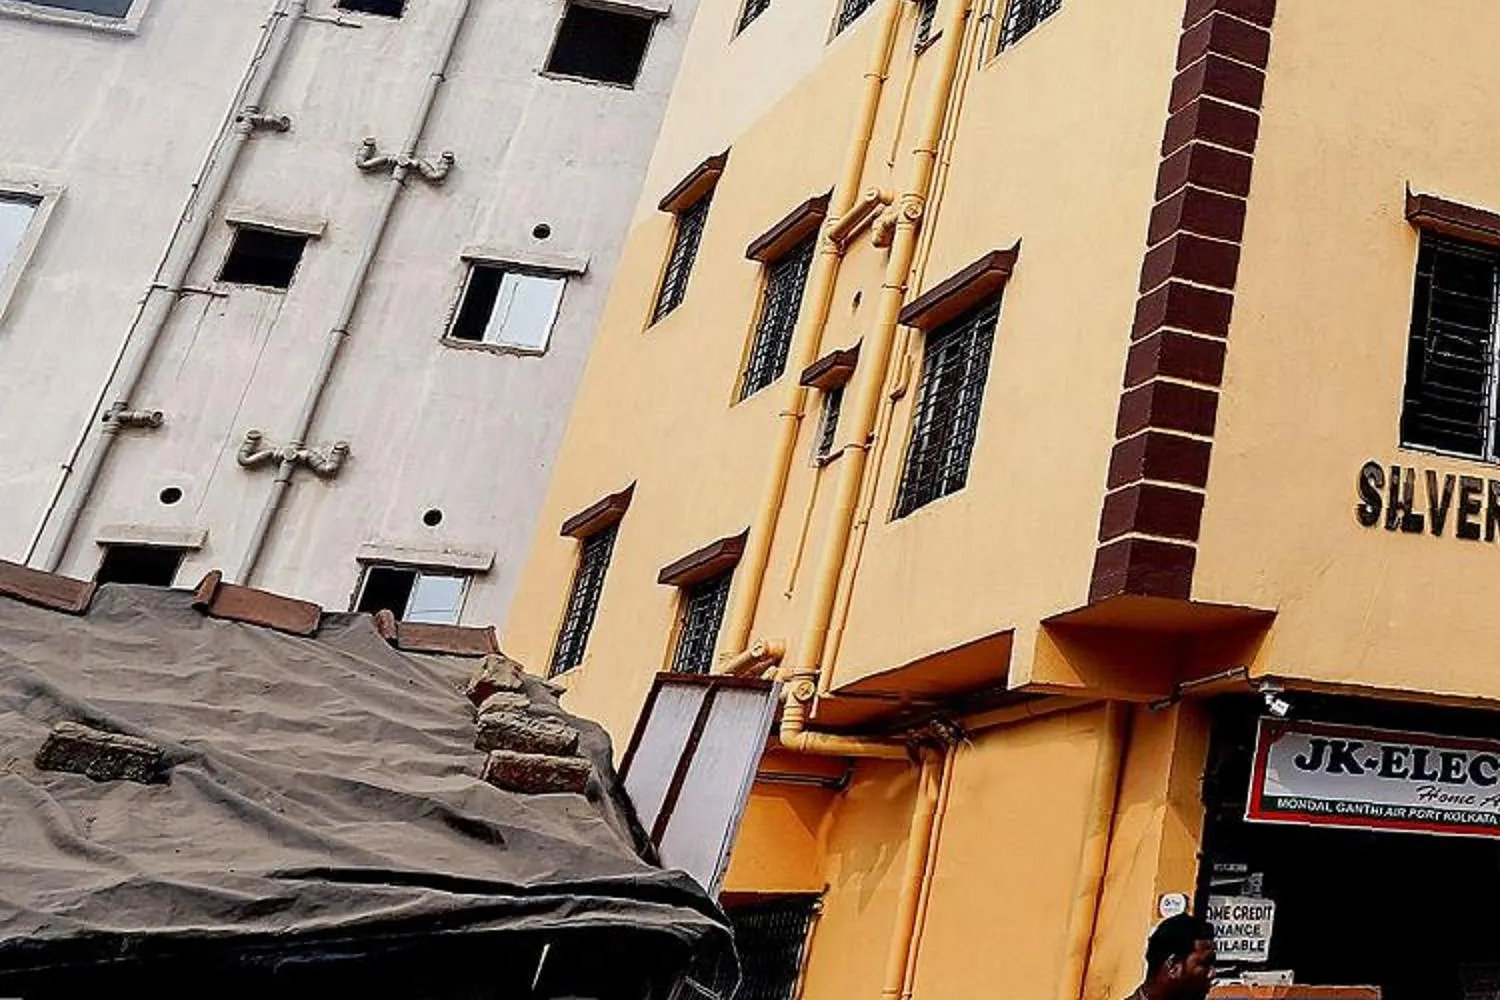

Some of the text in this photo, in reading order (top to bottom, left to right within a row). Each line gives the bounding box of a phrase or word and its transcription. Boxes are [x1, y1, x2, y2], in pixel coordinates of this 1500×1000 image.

[1417, 786, 1475, 804] Home
[1277, 798, 1333, 813] MONDAL
[1384, 807, 1407, 818] AIR
[1408, 808, 1440, 821] PORT
[1443, 811, 1498, 825] KOLKATA
[1232, 906, 1273, 921] CREDIT
[1215, 941, 1265, 954] ILABLE
